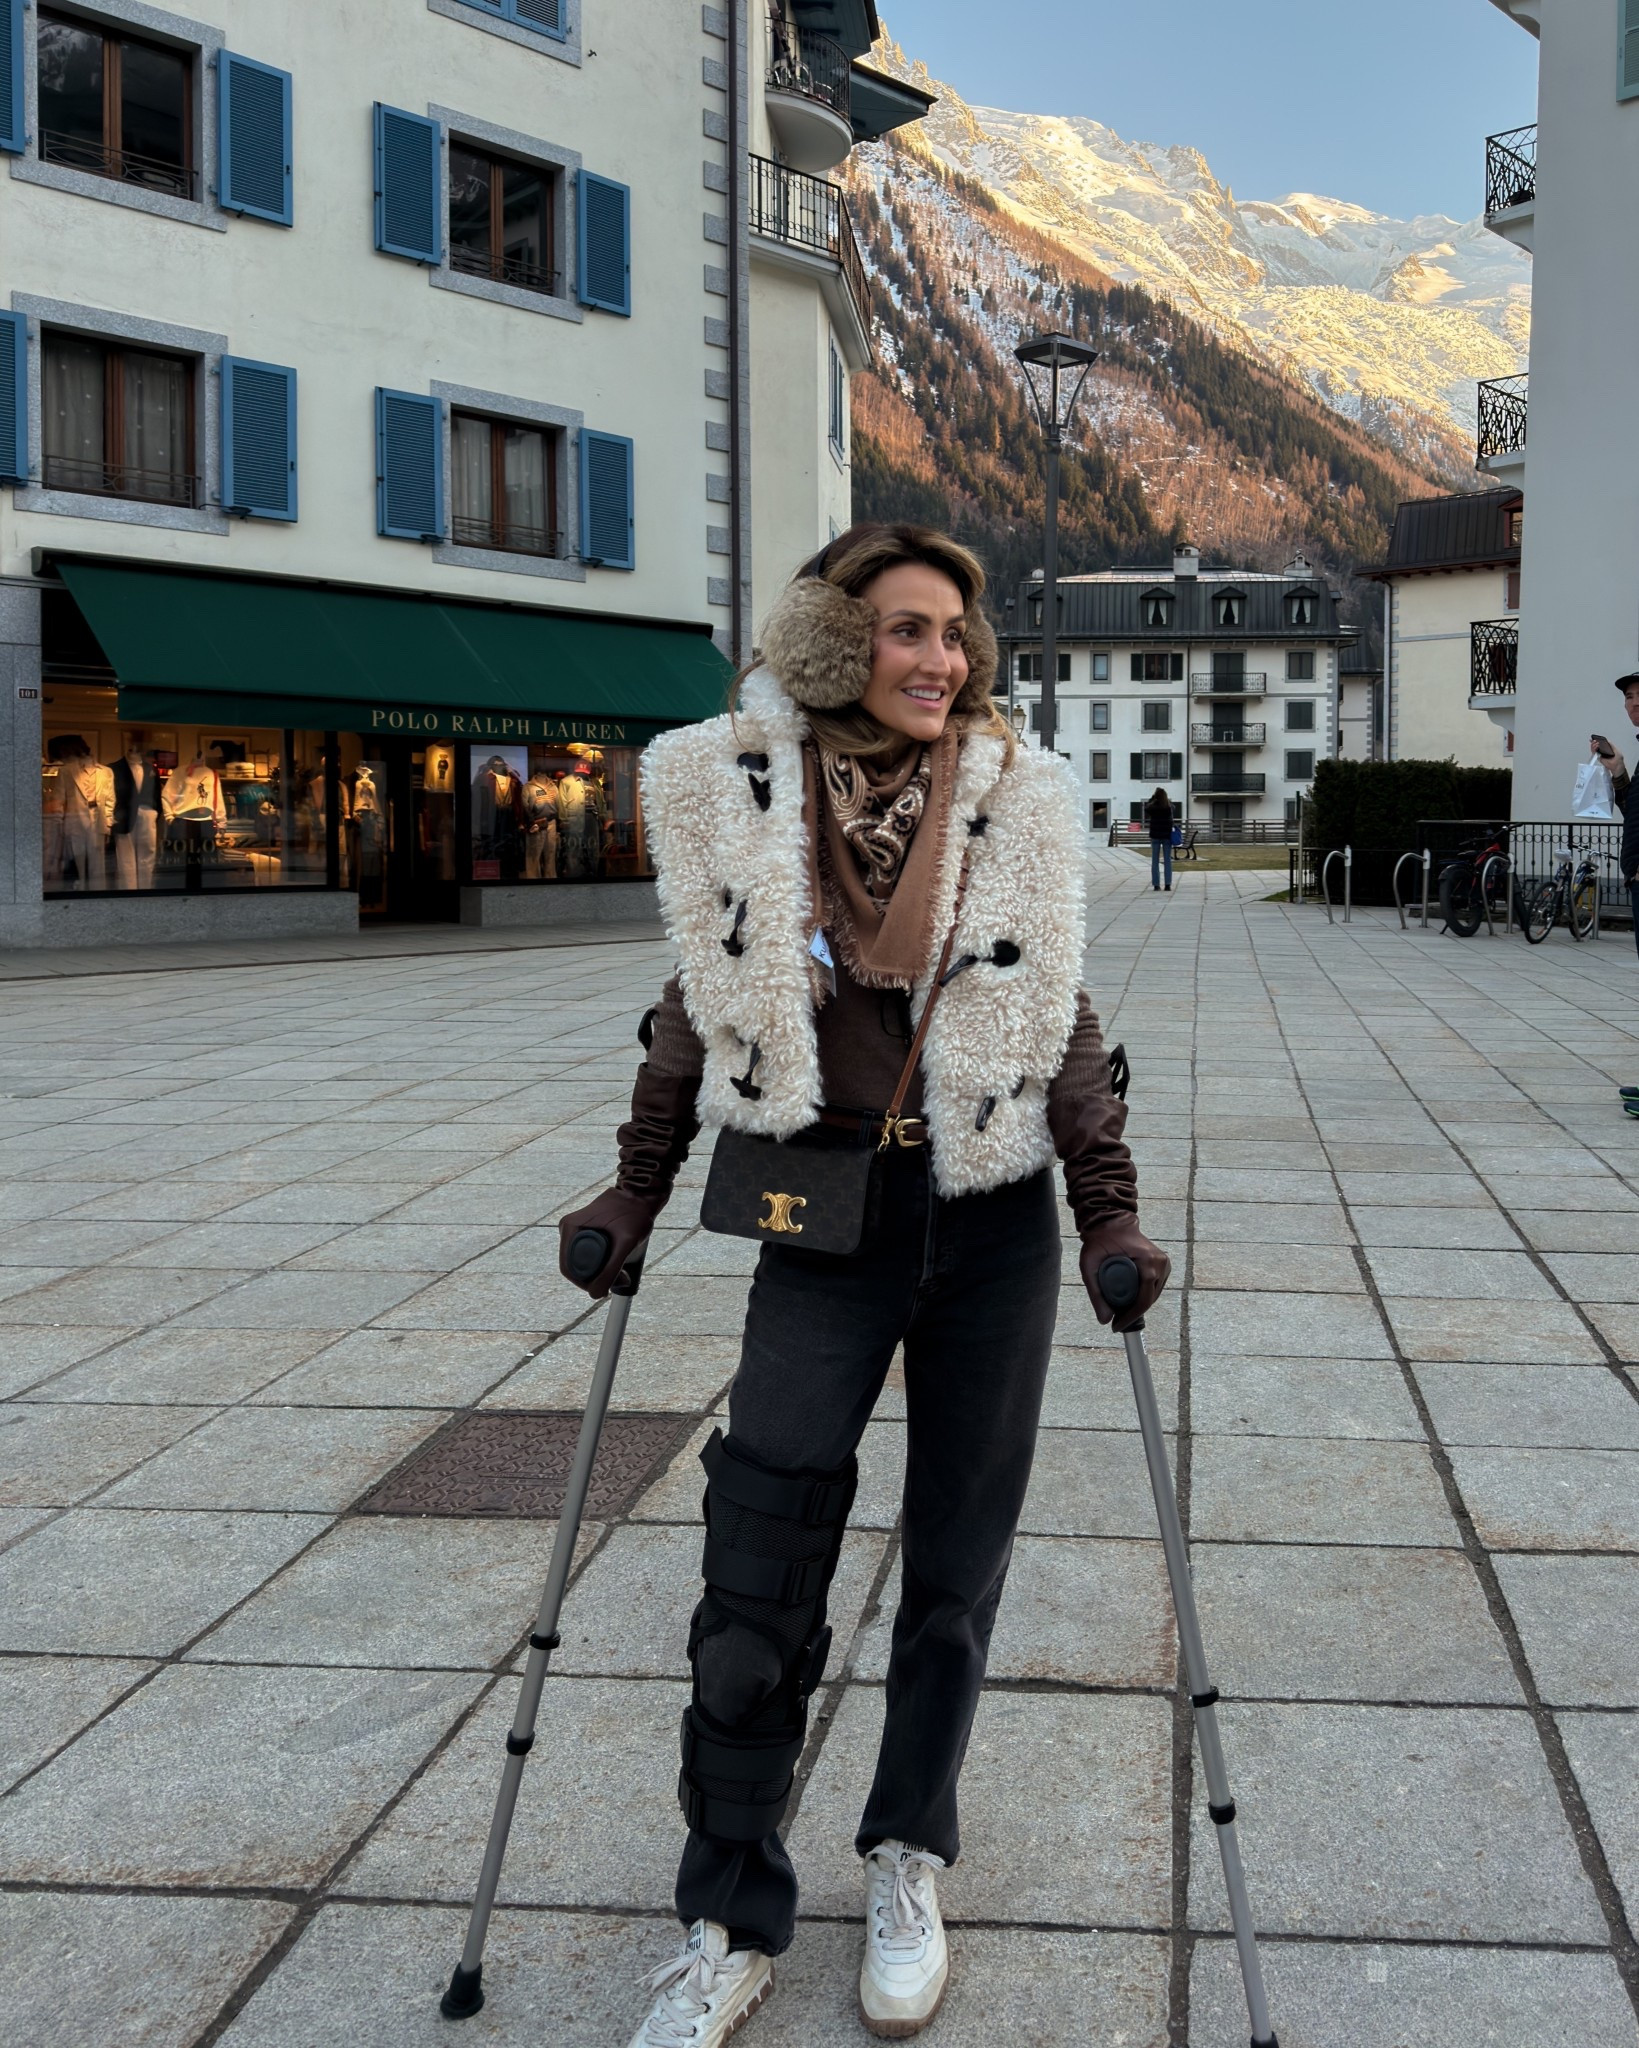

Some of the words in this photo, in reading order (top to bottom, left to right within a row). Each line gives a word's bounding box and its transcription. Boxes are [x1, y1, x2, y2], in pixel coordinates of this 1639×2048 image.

[21, 690, 35, 698] 101
[371, 710, 438, 731] POLO
[452, 715, 530, 736] RALPH
[543, 720, 626, 740] LAUREN
[159, 838, 216, 854] POLO
